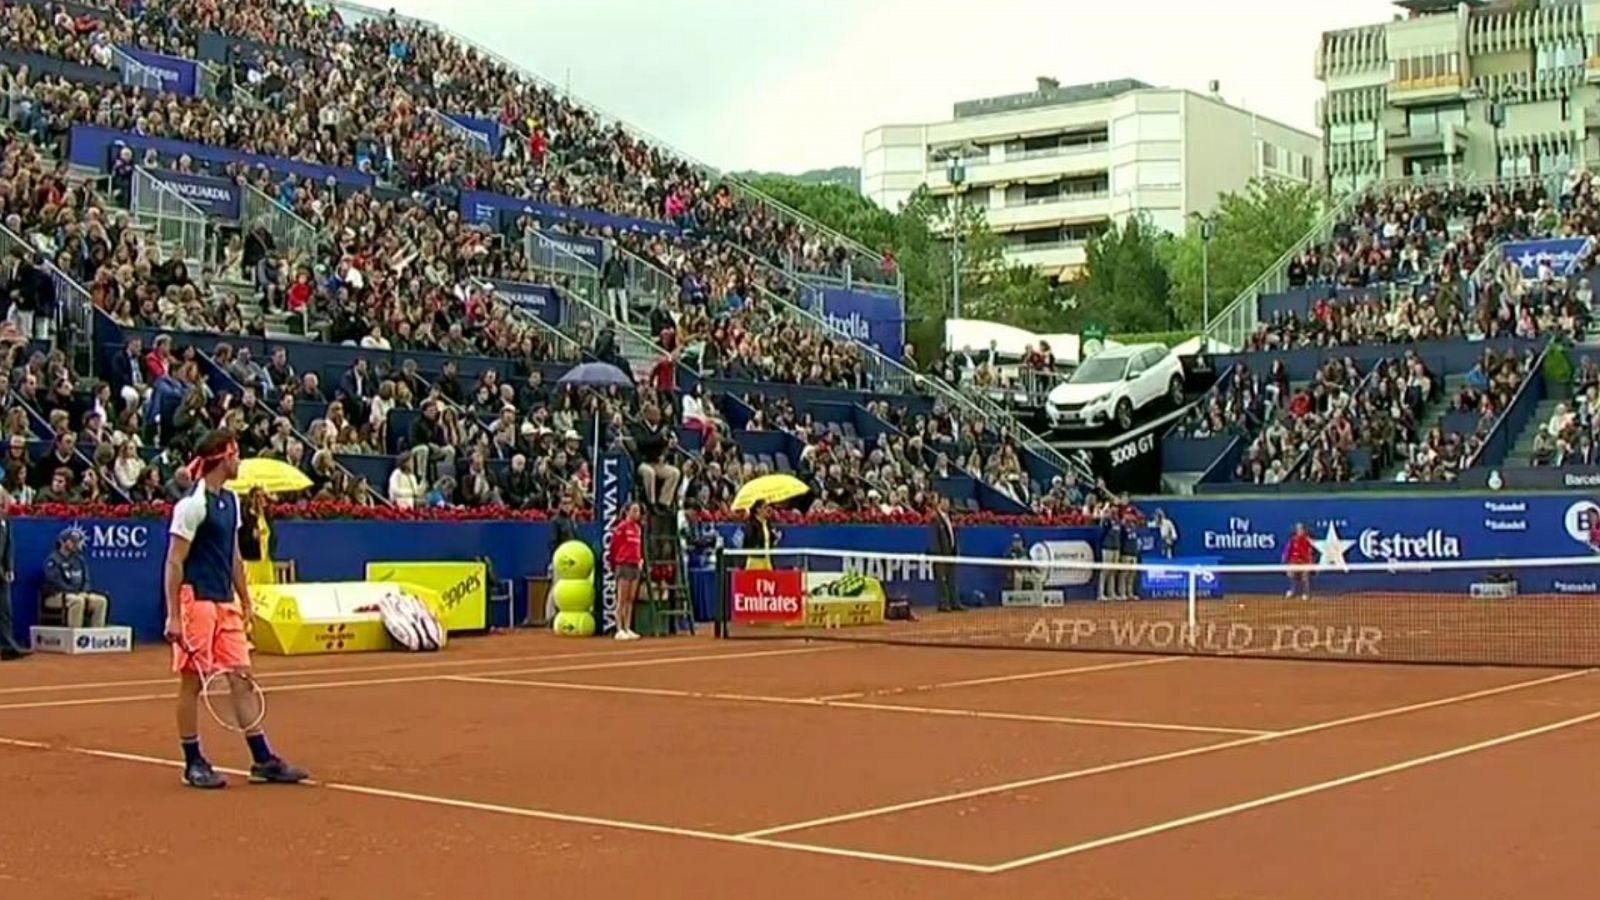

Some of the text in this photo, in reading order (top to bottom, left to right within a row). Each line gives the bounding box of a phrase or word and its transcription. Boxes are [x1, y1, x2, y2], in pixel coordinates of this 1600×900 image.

[1110, 433, 1154, 467] 3008 GT
[1229, 516, 1250, 532] Fly
[92, 525, 148, 548] MSC
[1204, 530, 1276, 549] Emirates
[1359, 527, 1461, 559] Estrella
[842, 555, 934, 581] MAPFR
[756, 578, 776, 595] Fly
[734, 592, 799, 613] Emirates
[1024, 617, 1383, 656] ATP WORLD TOUR
